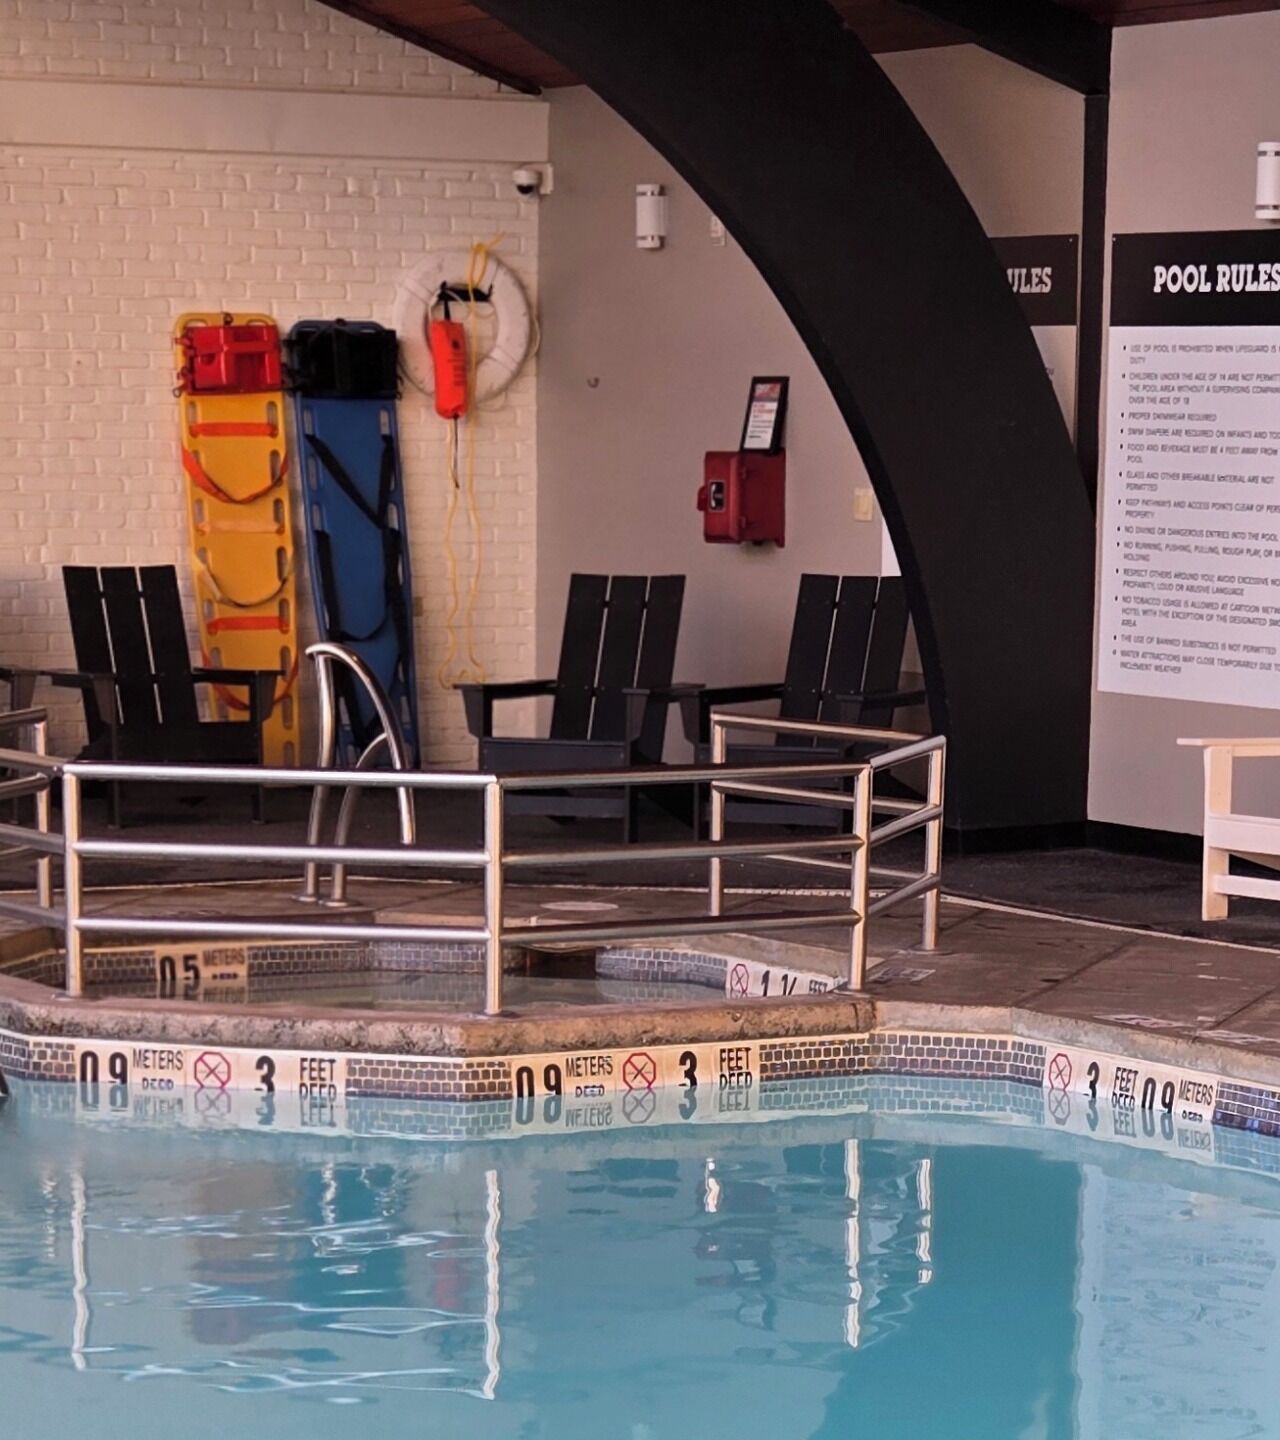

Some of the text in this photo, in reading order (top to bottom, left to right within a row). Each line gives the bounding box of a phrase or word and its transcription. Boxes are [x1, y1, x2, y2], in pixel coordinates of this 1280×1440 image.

[1006, 267, 1052, 293] ULES
[1153, 264, 1212, 293] POOL
[133, 1048, 183, 1071] METERS
[300, 1057, 336, 1081] FEET
[566, 1055, 614, 1077] METERS
[678, 1047, 751, 1088] 3 FEET
[1114, 1067, 1138, 1095] FEET
[1178, 1079, 1214, 1106] METERS
